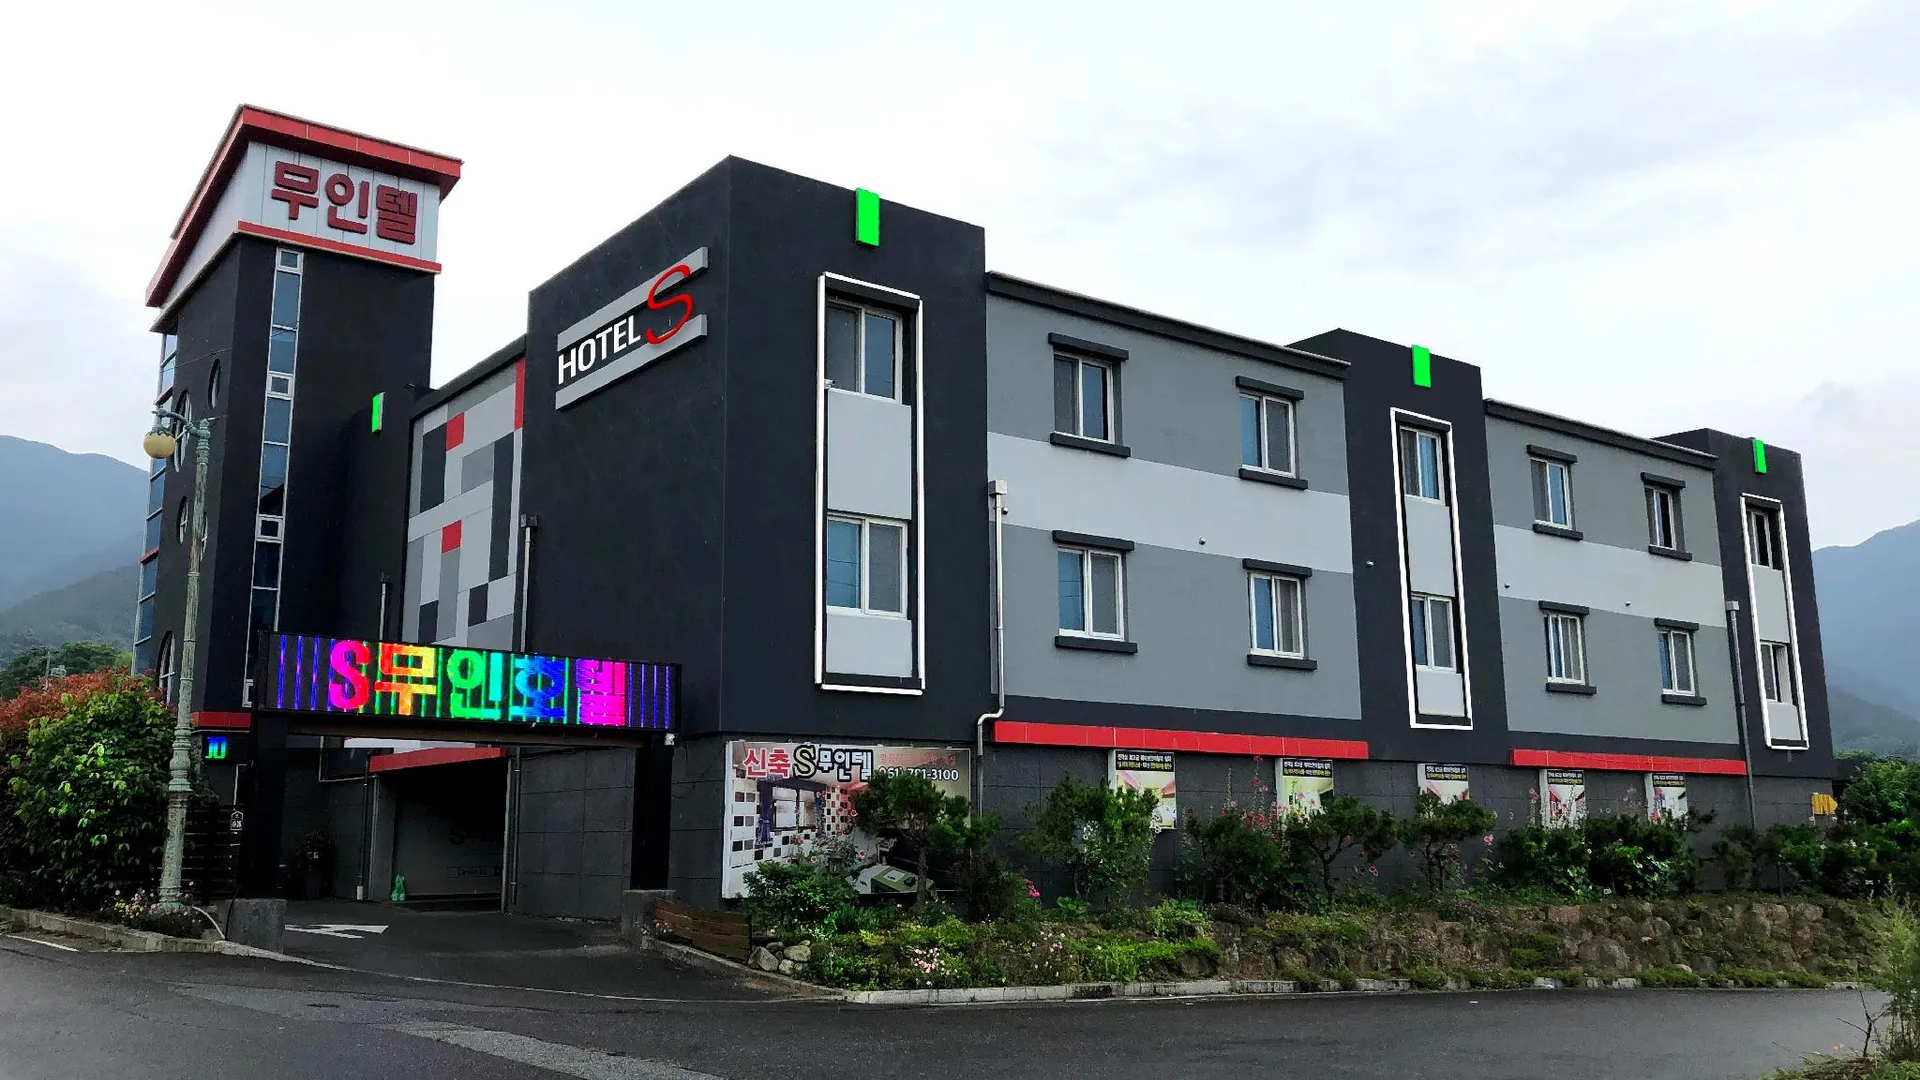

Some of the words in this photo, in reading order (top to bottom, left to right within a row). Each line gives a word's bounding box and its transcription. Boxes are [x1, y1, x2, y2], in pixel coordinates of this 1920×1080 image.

[271, 161, 418, 245] 무인텔
[558, 315, 641, 385] HOTEL
[645, 264, 693, 344] S
[329, 639, 626, 726] S무인호텔
[743, 748, 791, 779] 신축
[793, 745, 873, 782] S무인텔
